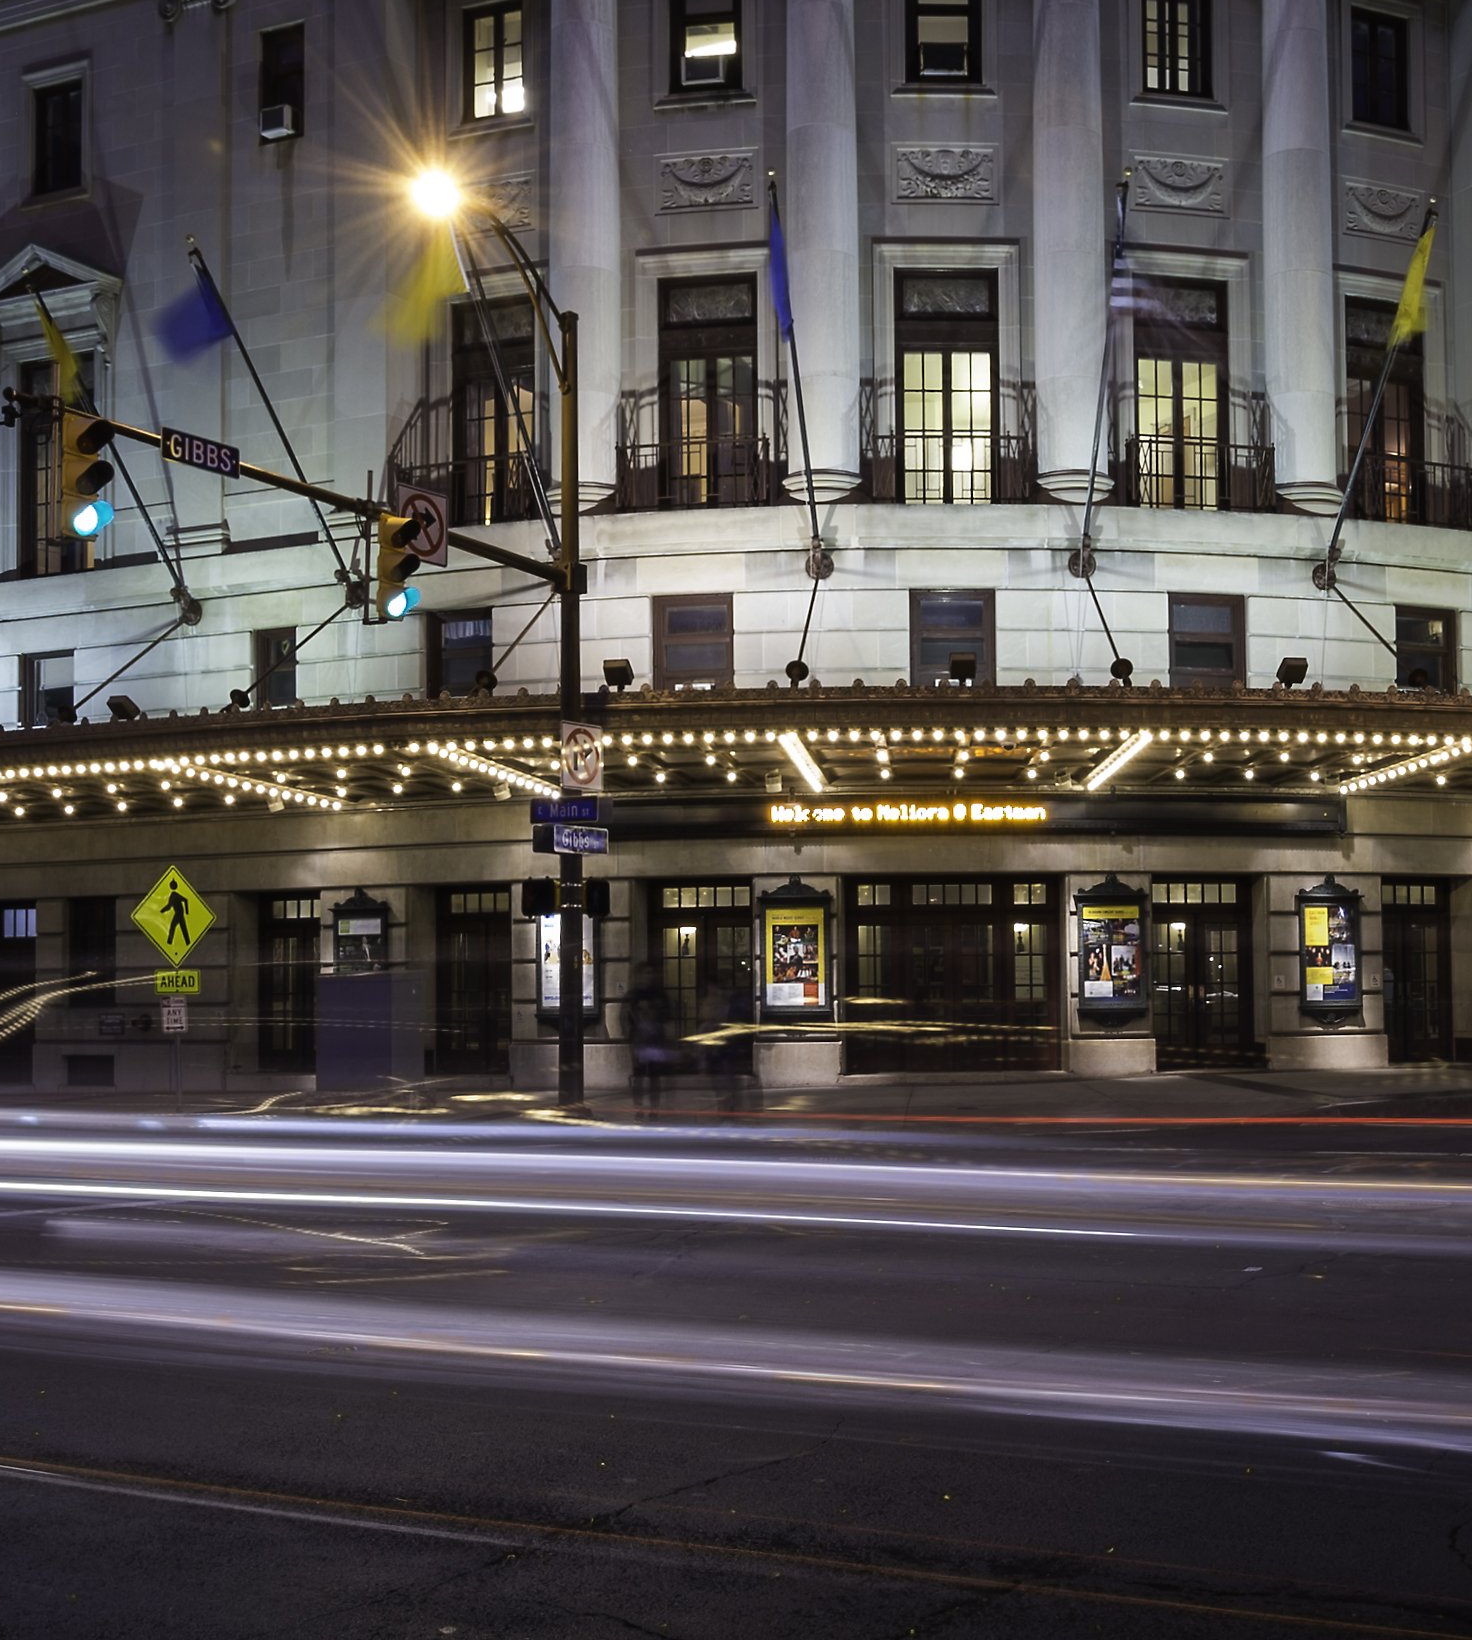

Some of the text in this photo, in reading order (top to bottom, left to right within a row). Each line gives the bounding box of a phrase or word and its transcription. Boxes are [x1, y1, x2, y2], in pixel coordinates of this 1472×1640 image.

[170, 434, 232, 472] GIBBS
[549, 802, 578, 818] Main
[851, 805, 874, 821] to
[969, 802, 1046, 821] Eastman
[561, 830, 590, 849] Gibbs
[160, 975, 195, 988] AHEAD
[167, 1008, 182, 1016] ANY
